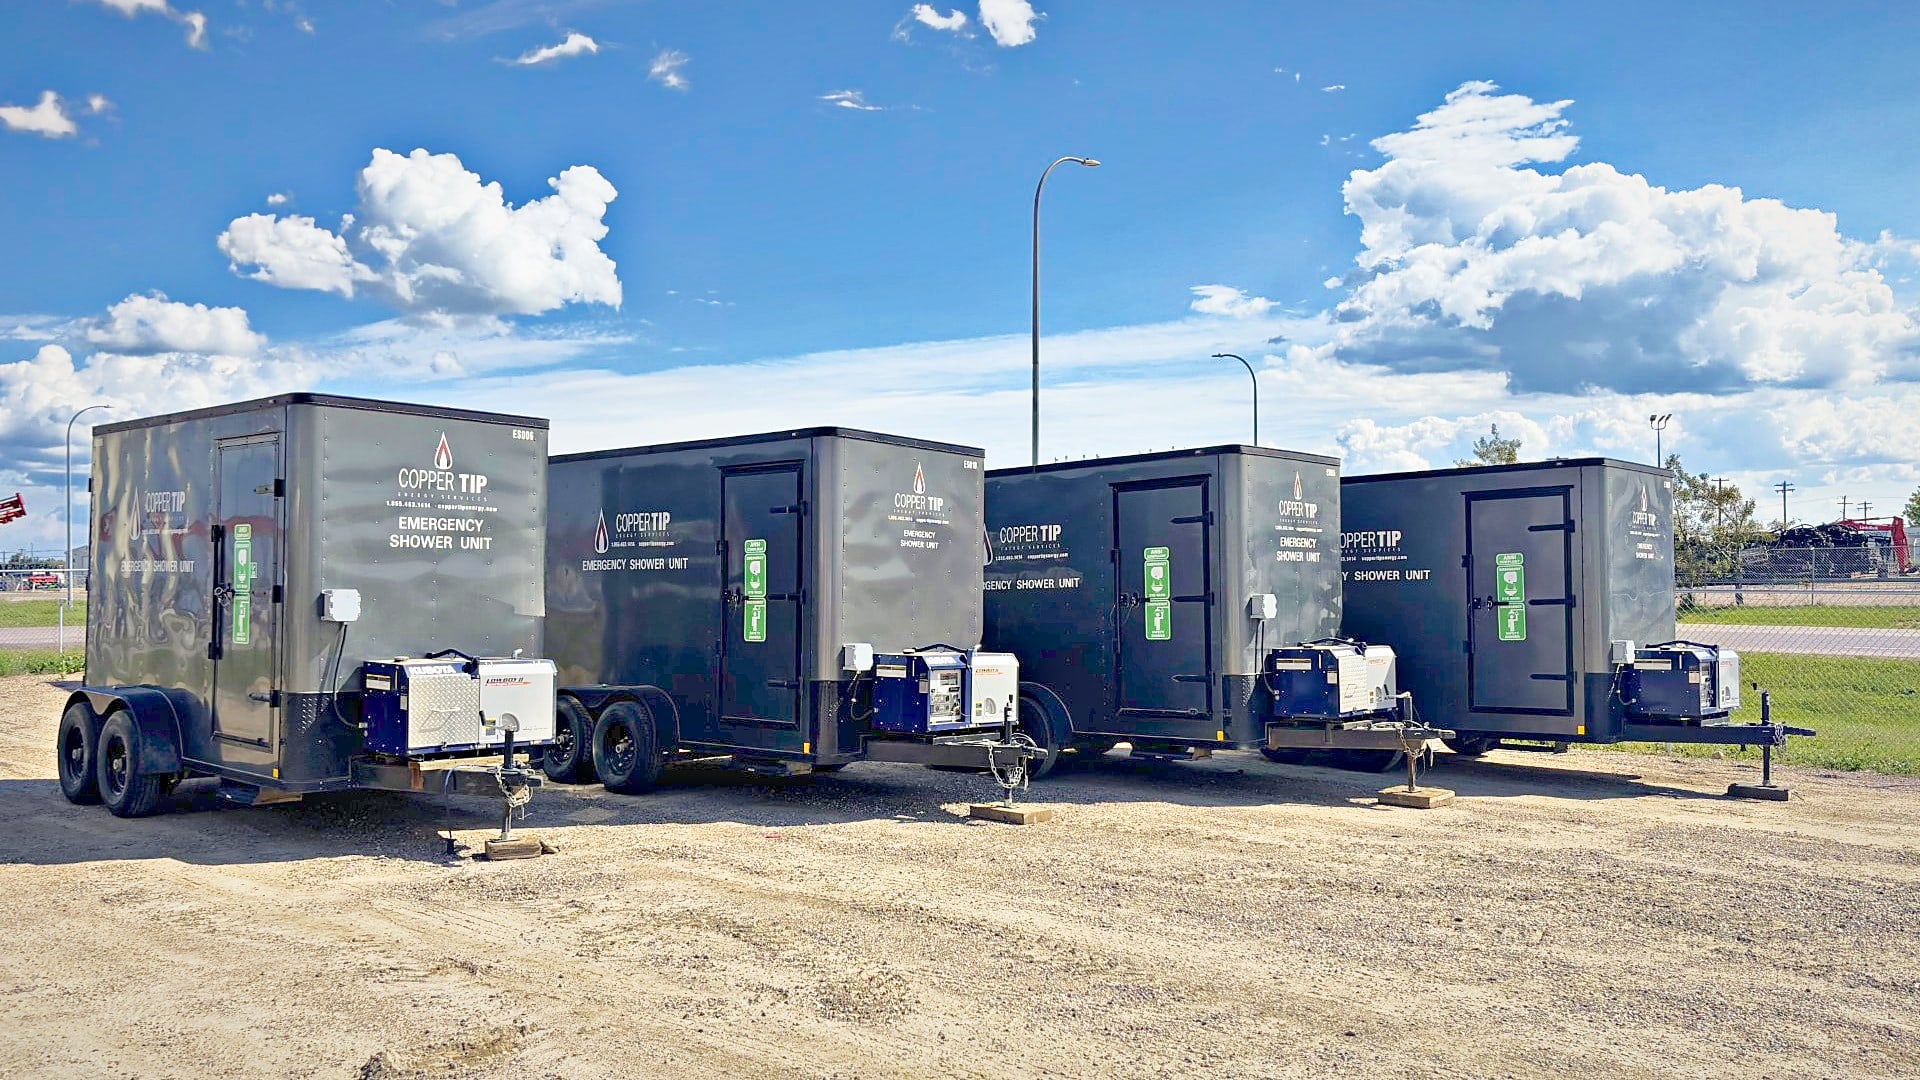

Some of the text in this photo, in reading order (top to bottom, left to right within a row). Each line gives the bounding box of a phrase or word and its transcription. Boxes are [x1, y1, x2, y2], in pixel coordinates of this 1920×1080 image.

[398, 468, 488, 494] COPPER TIP
[146, 491, 186, 512] COPPER TIP
[441, 494, 488, 502] SERVICES
[895, 493, 944, 511] COPPER TIP
[1279, 500, 1318, 518] COPPER TIP
[398, 516, 484, 532] EMERGENCY
[615, 511, 671, 532] COPPER TIP
[904, 530, 936, 539] EMERGENCY
[1000, 525, 1061, 544] COPPER TIP
[1340, 531, 1401, 548] OPPER TIP
[389, 534, 492, 550] SHOWER UNIT
[900, 539, 939, 549] SHOWER UNIT
[1280, 536, 1316, 548] EMERGENCY
[1276, 551, 1320, 562] SHOWER UNIT
[153, 560, 178, 572] SHOWER
[180, 560, 194, 572] UNIT
[582, 558, 689, 571] EMERGENCY SHOWER UNIT
[1354, 571, 1400, 581] SHOWER
[1405, 570, 1431, 580] UNIT
[983, 578, 1080, 590] GENCY SHOWER UNIT
[408, 665, 456, 675] KUBOTA
